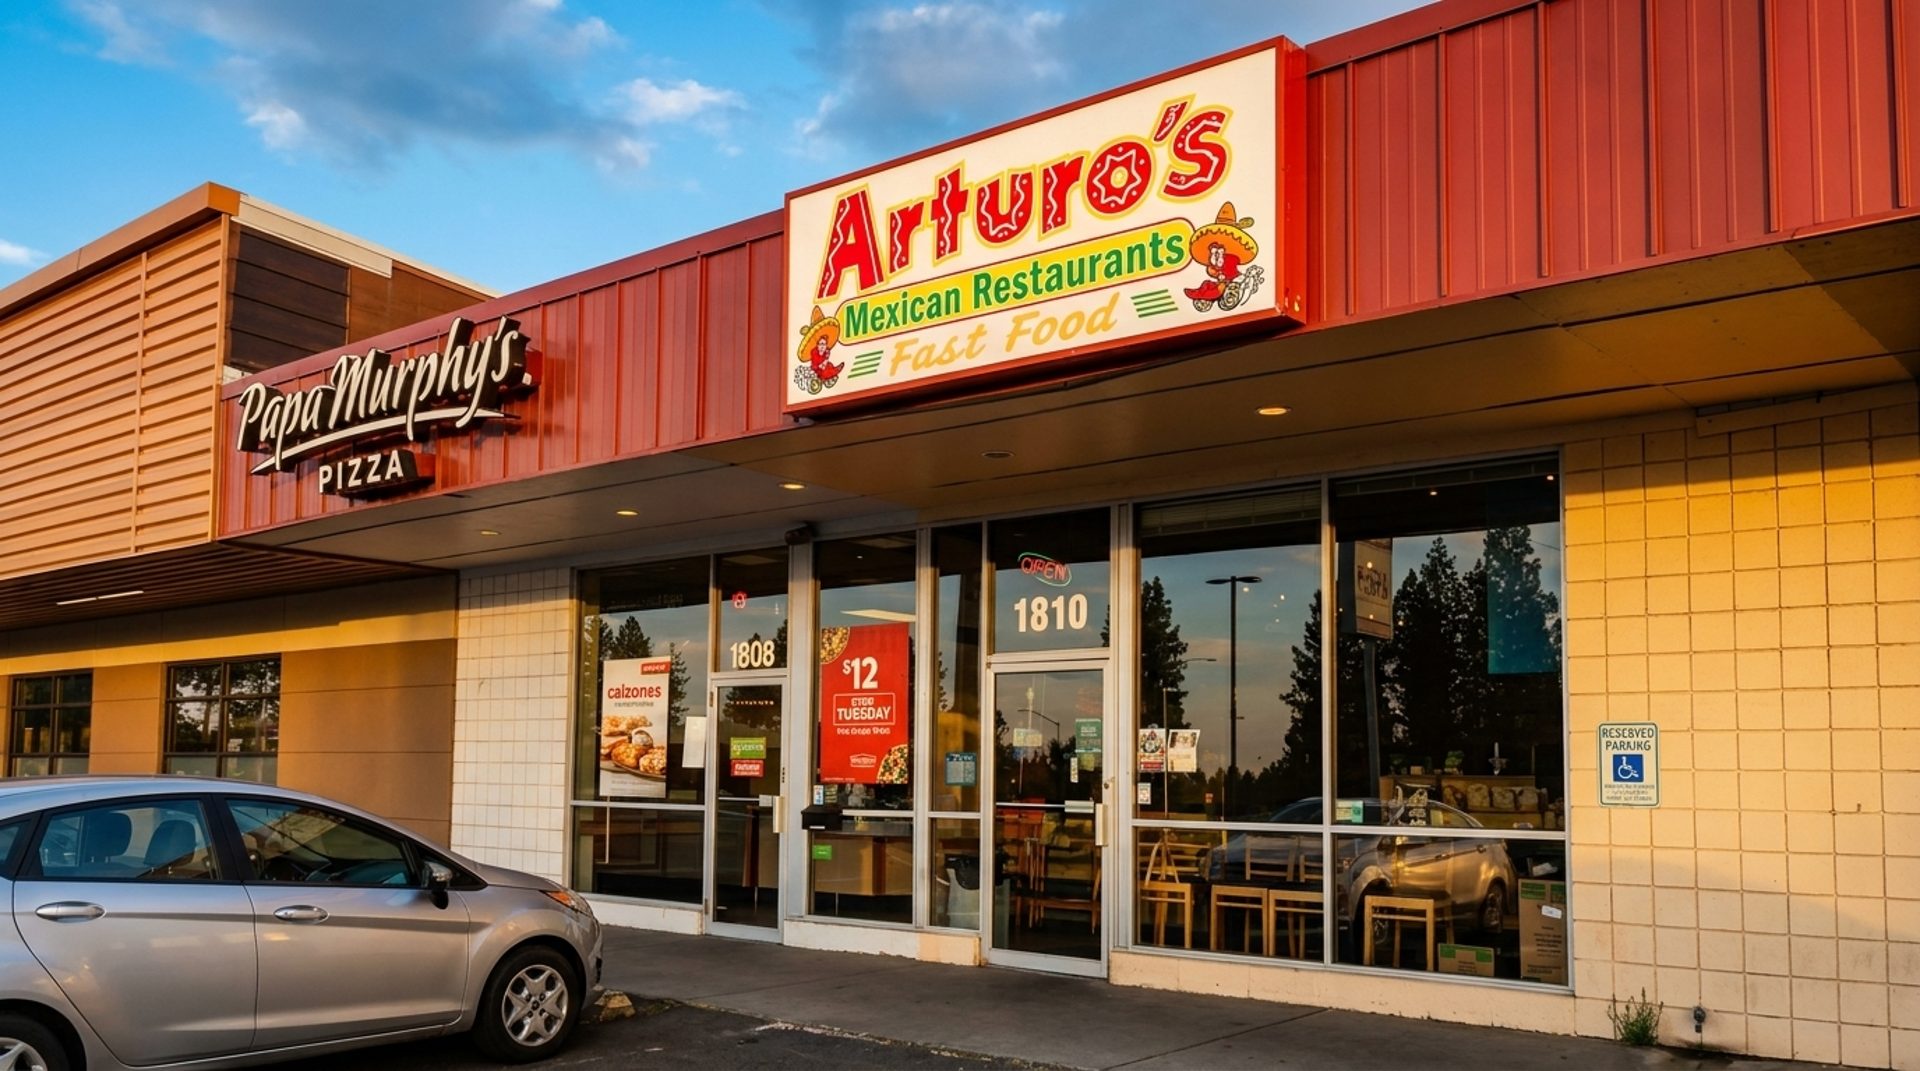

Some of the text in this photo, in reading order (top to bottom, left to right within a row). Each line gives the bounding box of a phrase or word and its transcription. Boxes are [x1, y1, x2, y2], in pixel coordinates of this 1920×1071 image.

[815, 97, 1230, 301] Arturo's
[845, 232, 1185, 339] Mexican Restaurants
[889, 293, 1121, 377] Fast Food
[236, 315, 519, 471] Papa Murphy's
[318, 449, 404, 494] PIZZA
[1021, 557, 1067, 581] OPEN
[1014, 593, 1088, 633] 1810
[730, 640, 775, 668] 1808
[842, 656, 879, 690] $12
[607, 683, 662, 699] calzones
[836, 706, 892, 721] TUESDAY
